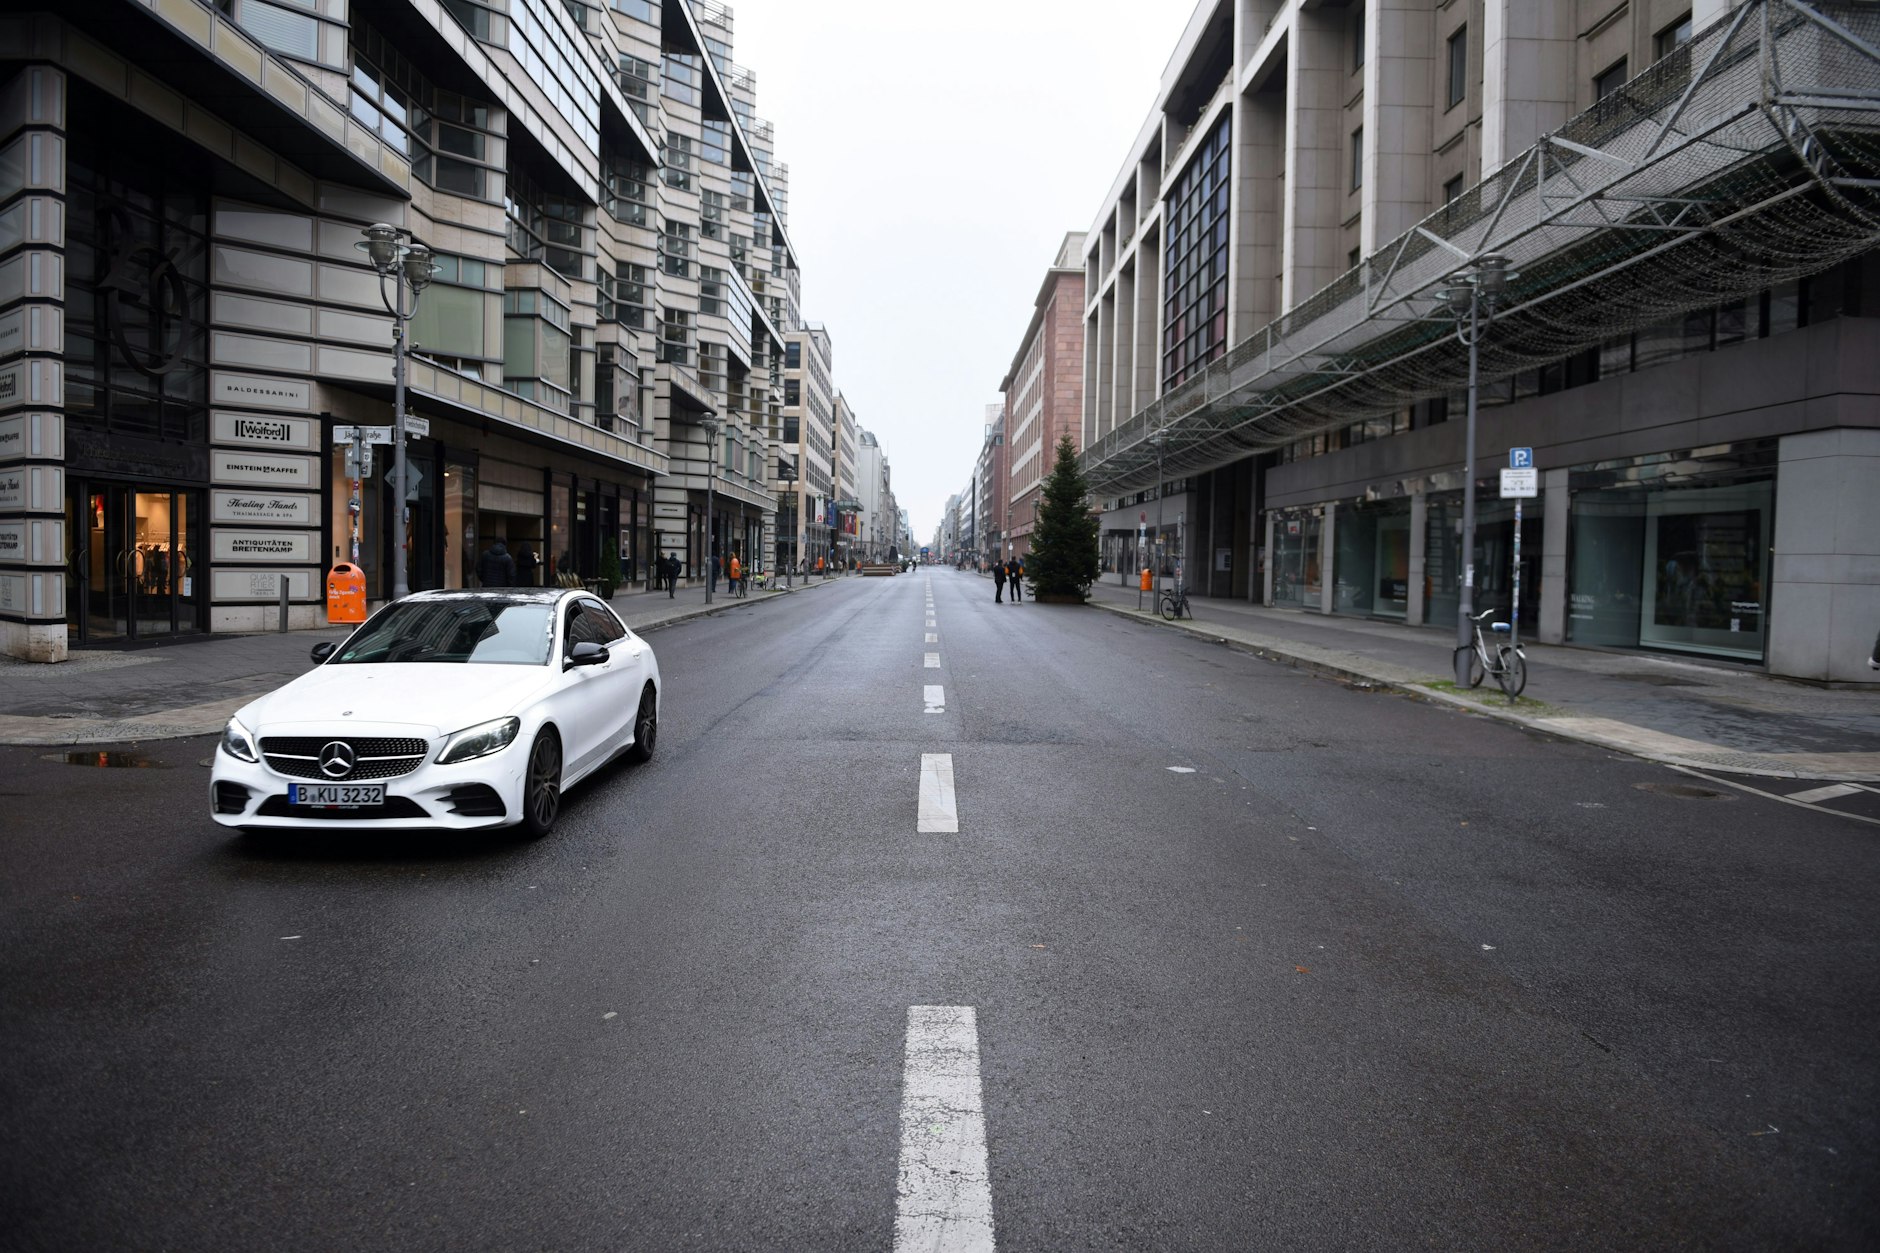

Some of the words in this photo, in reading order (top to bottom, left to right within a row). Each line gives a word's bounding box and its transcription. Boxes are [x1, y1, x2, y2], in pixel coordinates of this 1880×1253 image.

[227, 385, 298, 398] BALDESSARINI
[245, 424, 281, 436] Wolford
[226, 464, 262, 472] EINSTEIN
[227, 498, 265, 511] Healing
[267, 499, 298, 510] Hands
[232, 539, 293, 547] ANTIQUITÄTEN
[298, 787, 308, 802] B
[318, 787, 338, 802] KU
[341, 787, 381, 803] 3232
